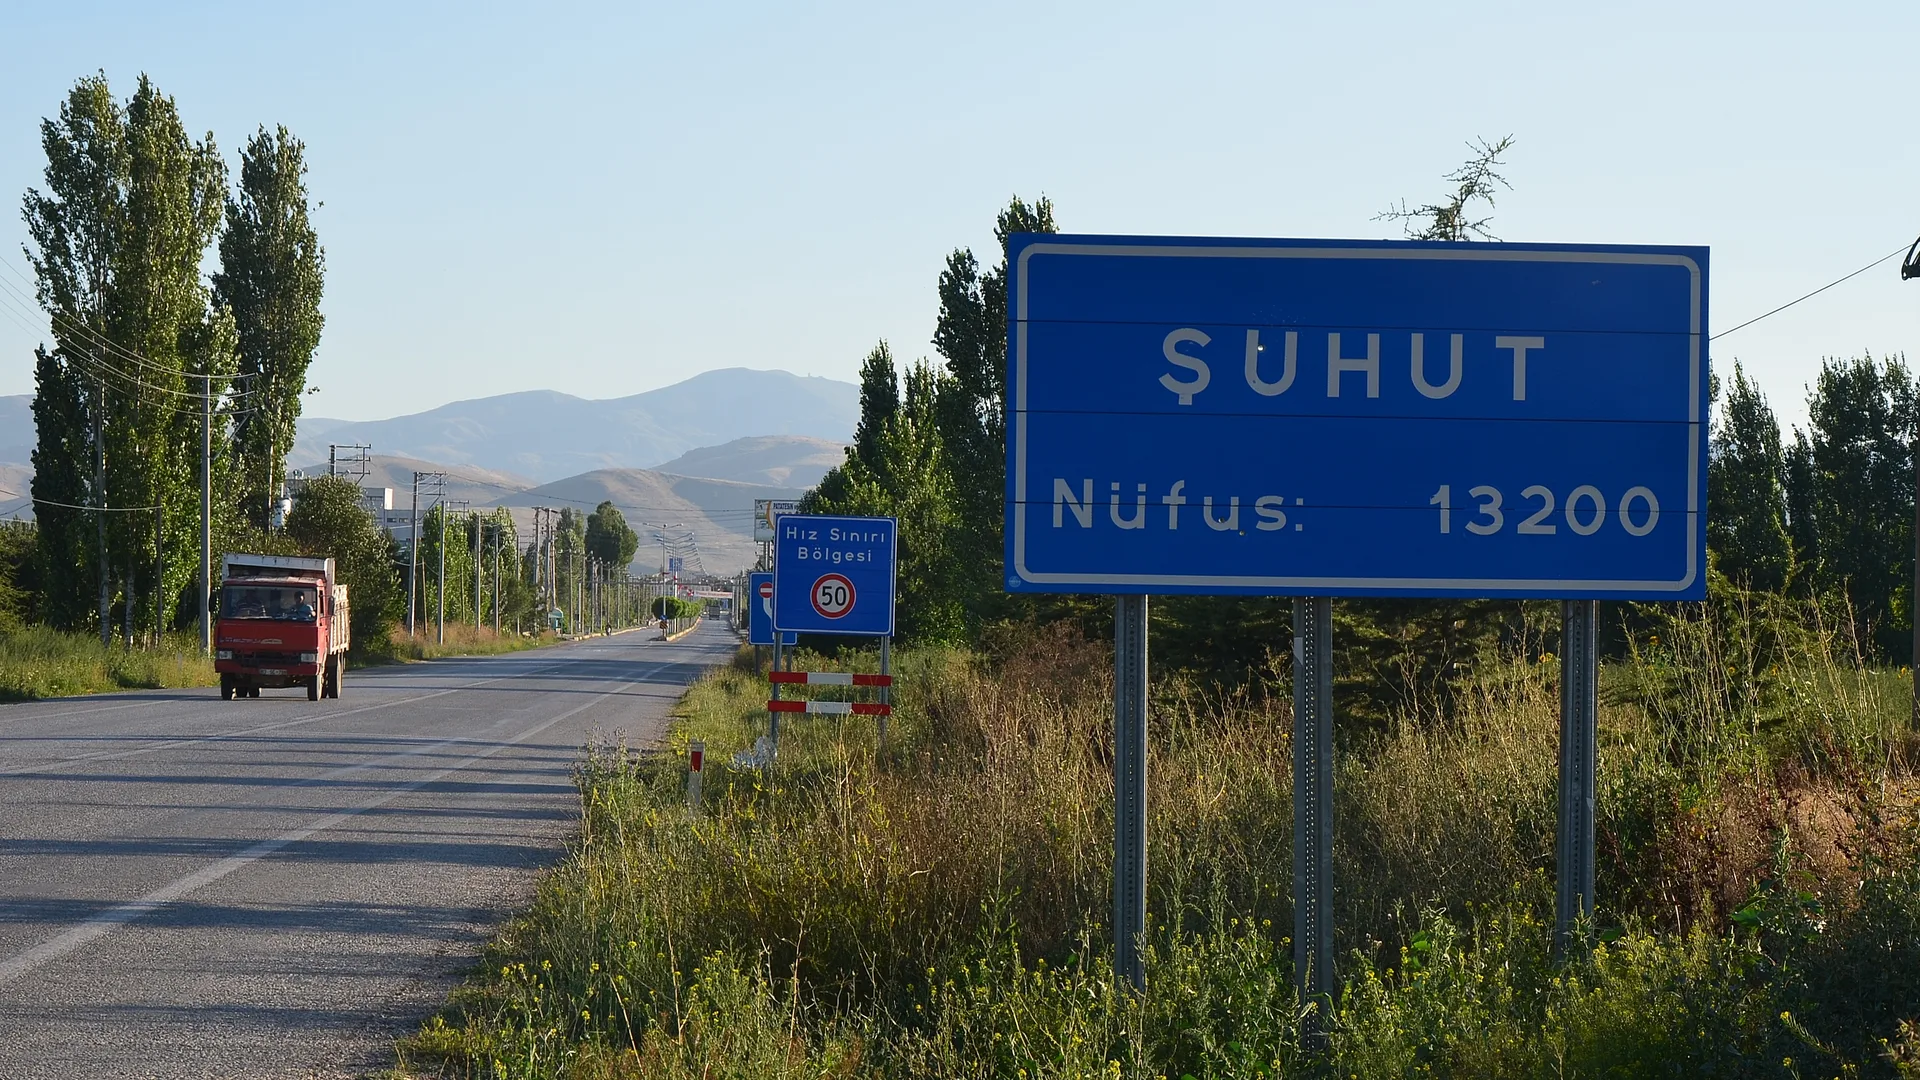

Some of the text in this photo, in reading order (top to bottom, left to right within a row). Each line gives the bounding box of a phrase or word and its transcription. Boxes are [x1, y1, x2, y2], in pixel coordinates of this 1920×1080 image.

[1158, 328, 1545, 406] ŞUHUT
[1053, 478, 1660, 537] Nüfus: 13200
[786, 526, 885, 543] Hız Sınırı
[798, 546, 871, 564] Bölgesi
[821, 586, 847, 606] 50
